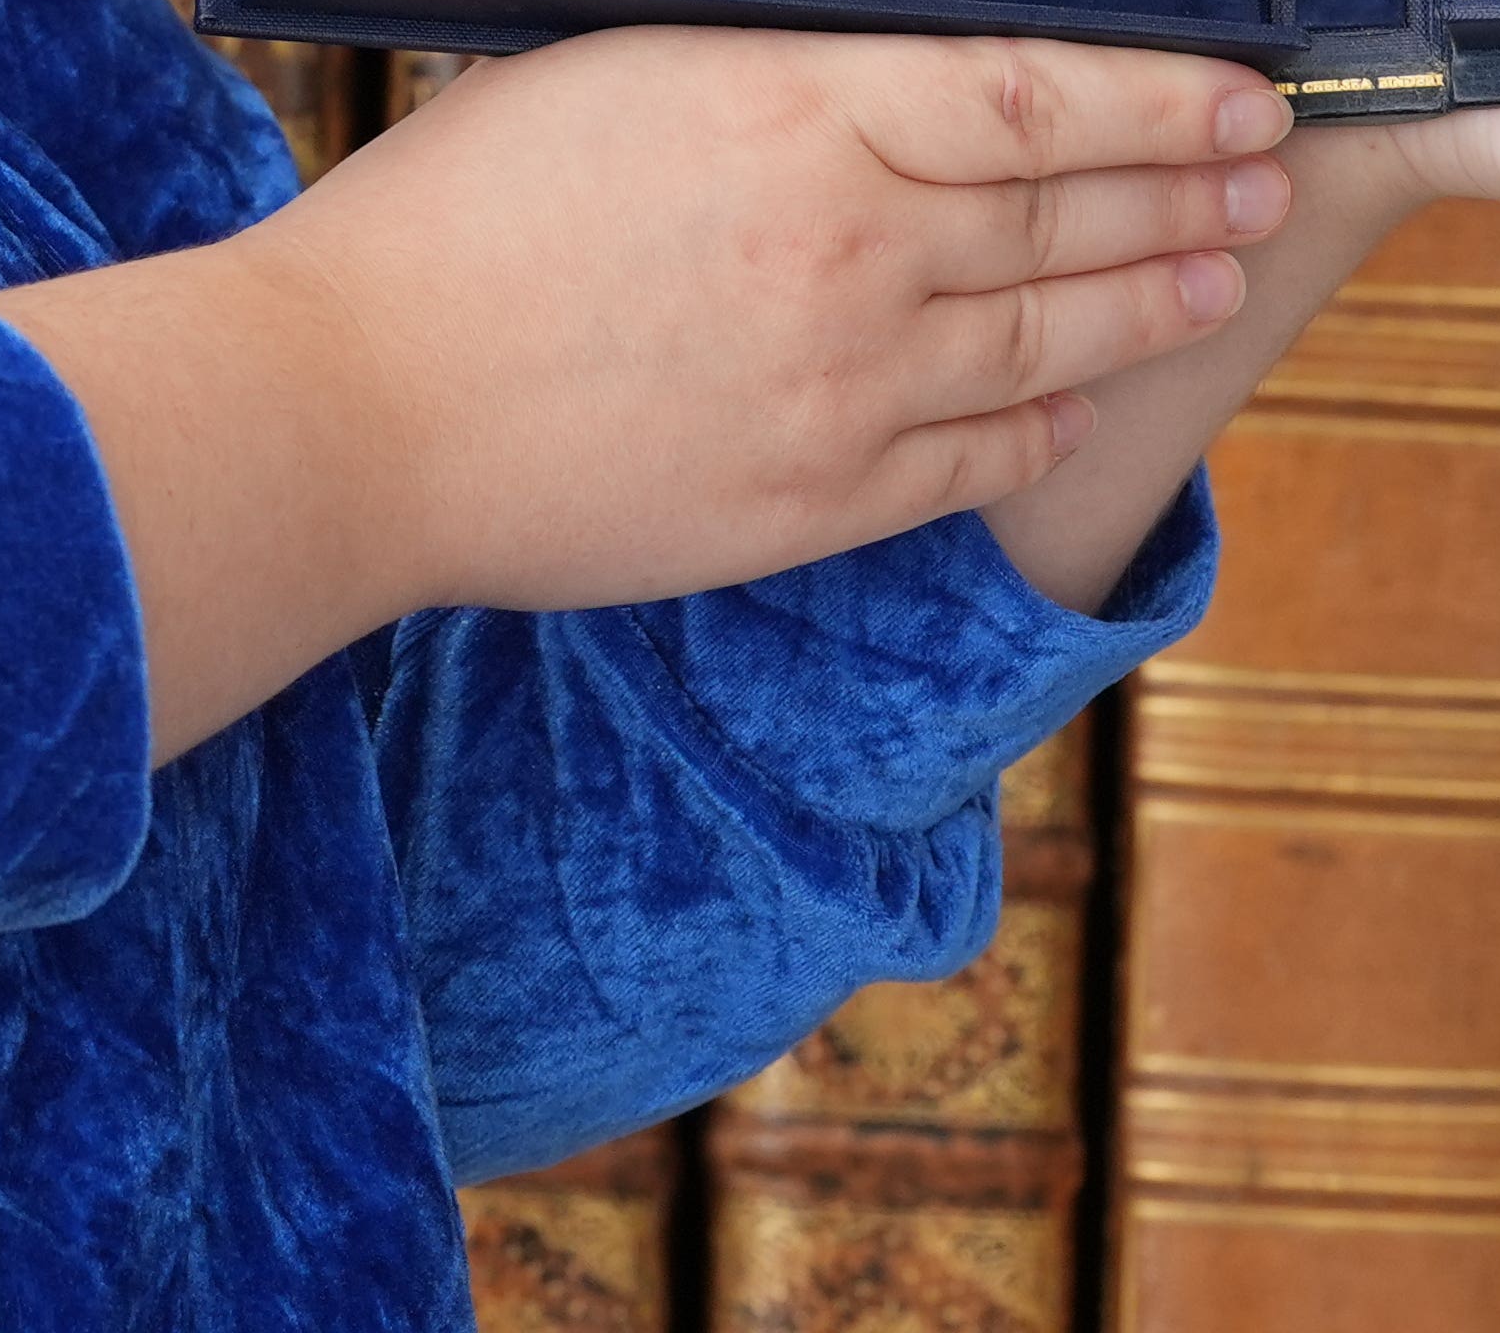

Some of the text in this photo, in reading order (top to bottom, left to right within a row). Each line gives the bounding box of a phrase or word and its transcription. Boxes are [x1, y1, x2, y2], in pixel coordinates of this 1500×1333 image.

[1274, 72, 1445, 97] HE CHELSEA BINDERY
